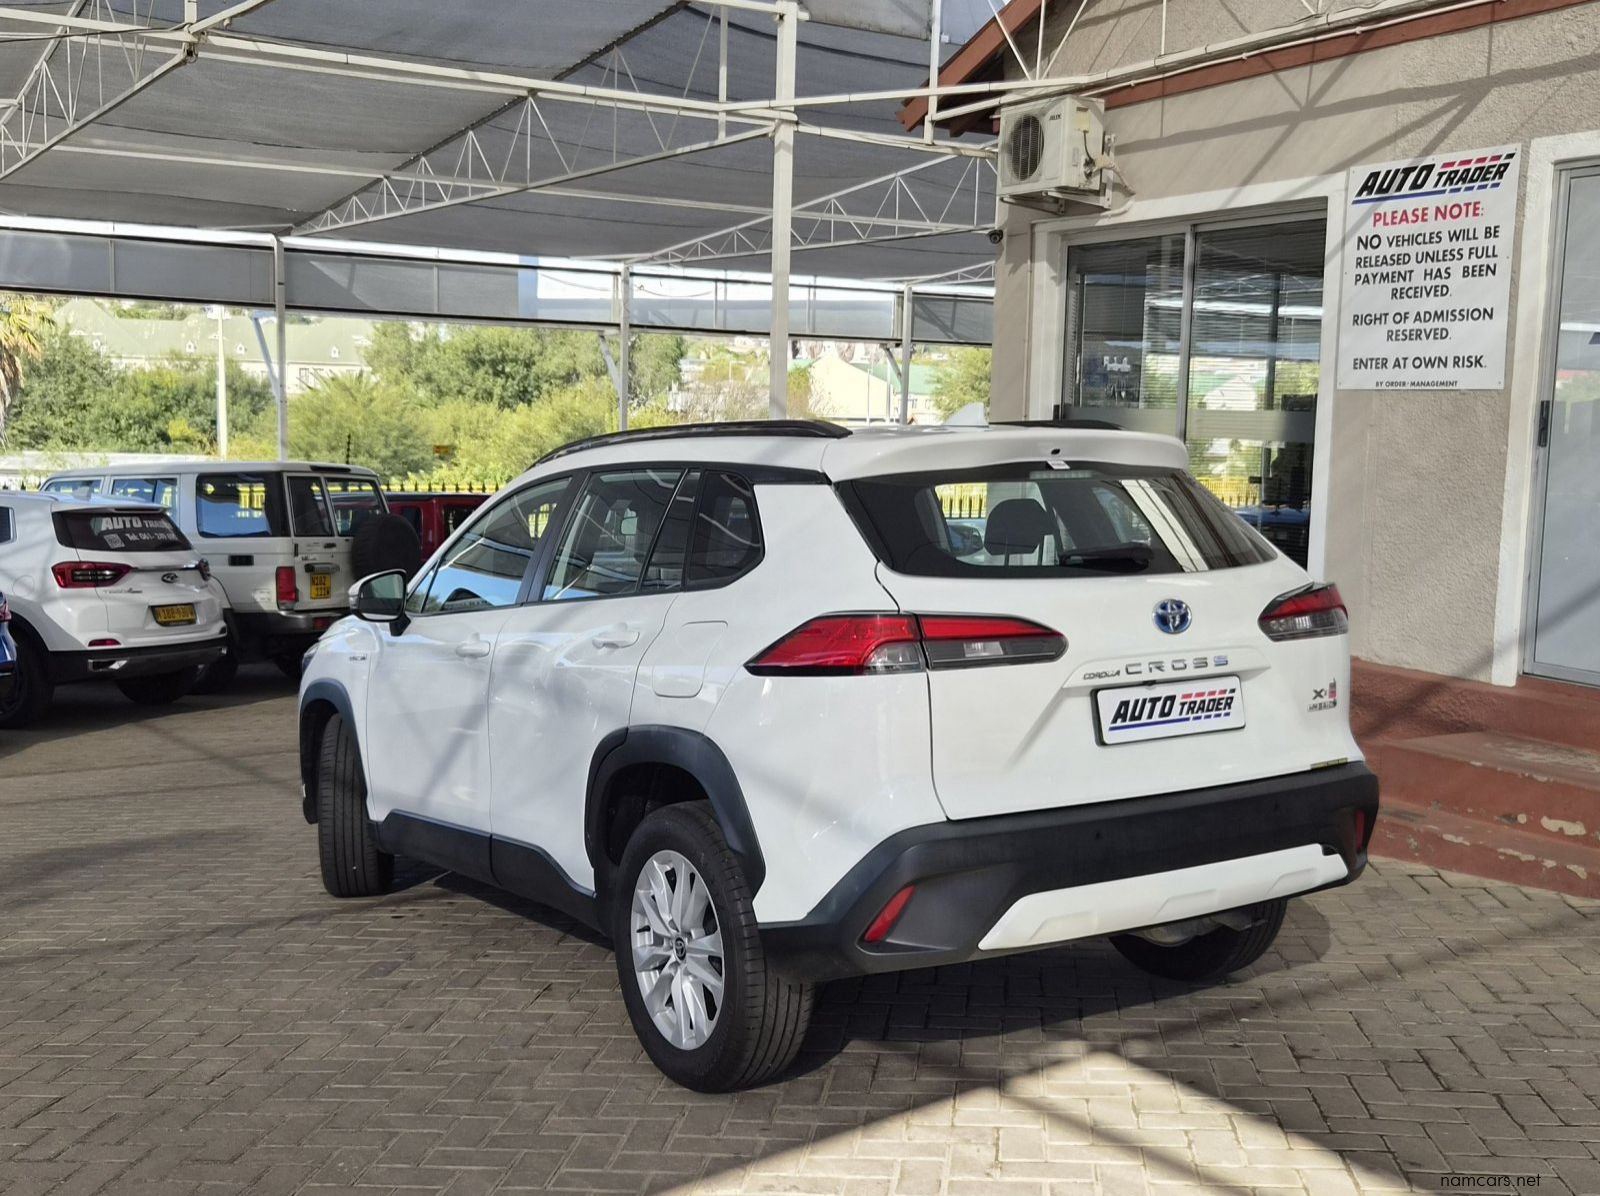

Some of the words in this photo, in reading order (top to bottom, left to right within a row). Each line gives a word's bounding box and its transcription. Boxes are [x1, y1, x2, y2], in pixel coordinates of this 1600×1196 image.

[1355, 163, 1436, 197] AUTO
[1433, 162, 1510, 188] TRADER
[1372, 207, 1429, 228] PLEASE
[1434, 201, 1484, 222] NOTE:
[1356, 234, 1382, 250] NO
[1386, 230, 1442, 248] VEHICLES
[1447, 228, 1479, 242] WILL
[1483, 225, 1500, 240] BE
[1355, 252, 1411, 269] RELEASED
[1415, 247, 1464, 264] UNLESS
[1467, 245, 1499, 260] FULL
[1354, 269, 1414, 286] PAYMENT
[1423, 267, 1451, 281] HAS
[1462, 263, 1497, 278] BEEN
[1390, 284, 1452, 300] RECEIVED.
[1352, 312, 1389, 326] RIGHT
[1392, 311, 1410, 325] OF
[1413, 307, 1494, 324] ADMISSION
[1386, 327, 1452, 342] RESERVED.
[1352, 357, 1388, 370] ENTER
[1392, 357, 1408, 369] AT
[1411, 356, 1448, 369] OWN
[1452, 355, 1487, 369] RISK.
[100, 516, 142, 531] AUTO
[1083, 669, 1121, 680] COROLLA
[1125, 655, 1228, 675] CROSS
[1111, 695, 1176, 724] AUTO
[1178, 696, 1234, 716] TRADER
